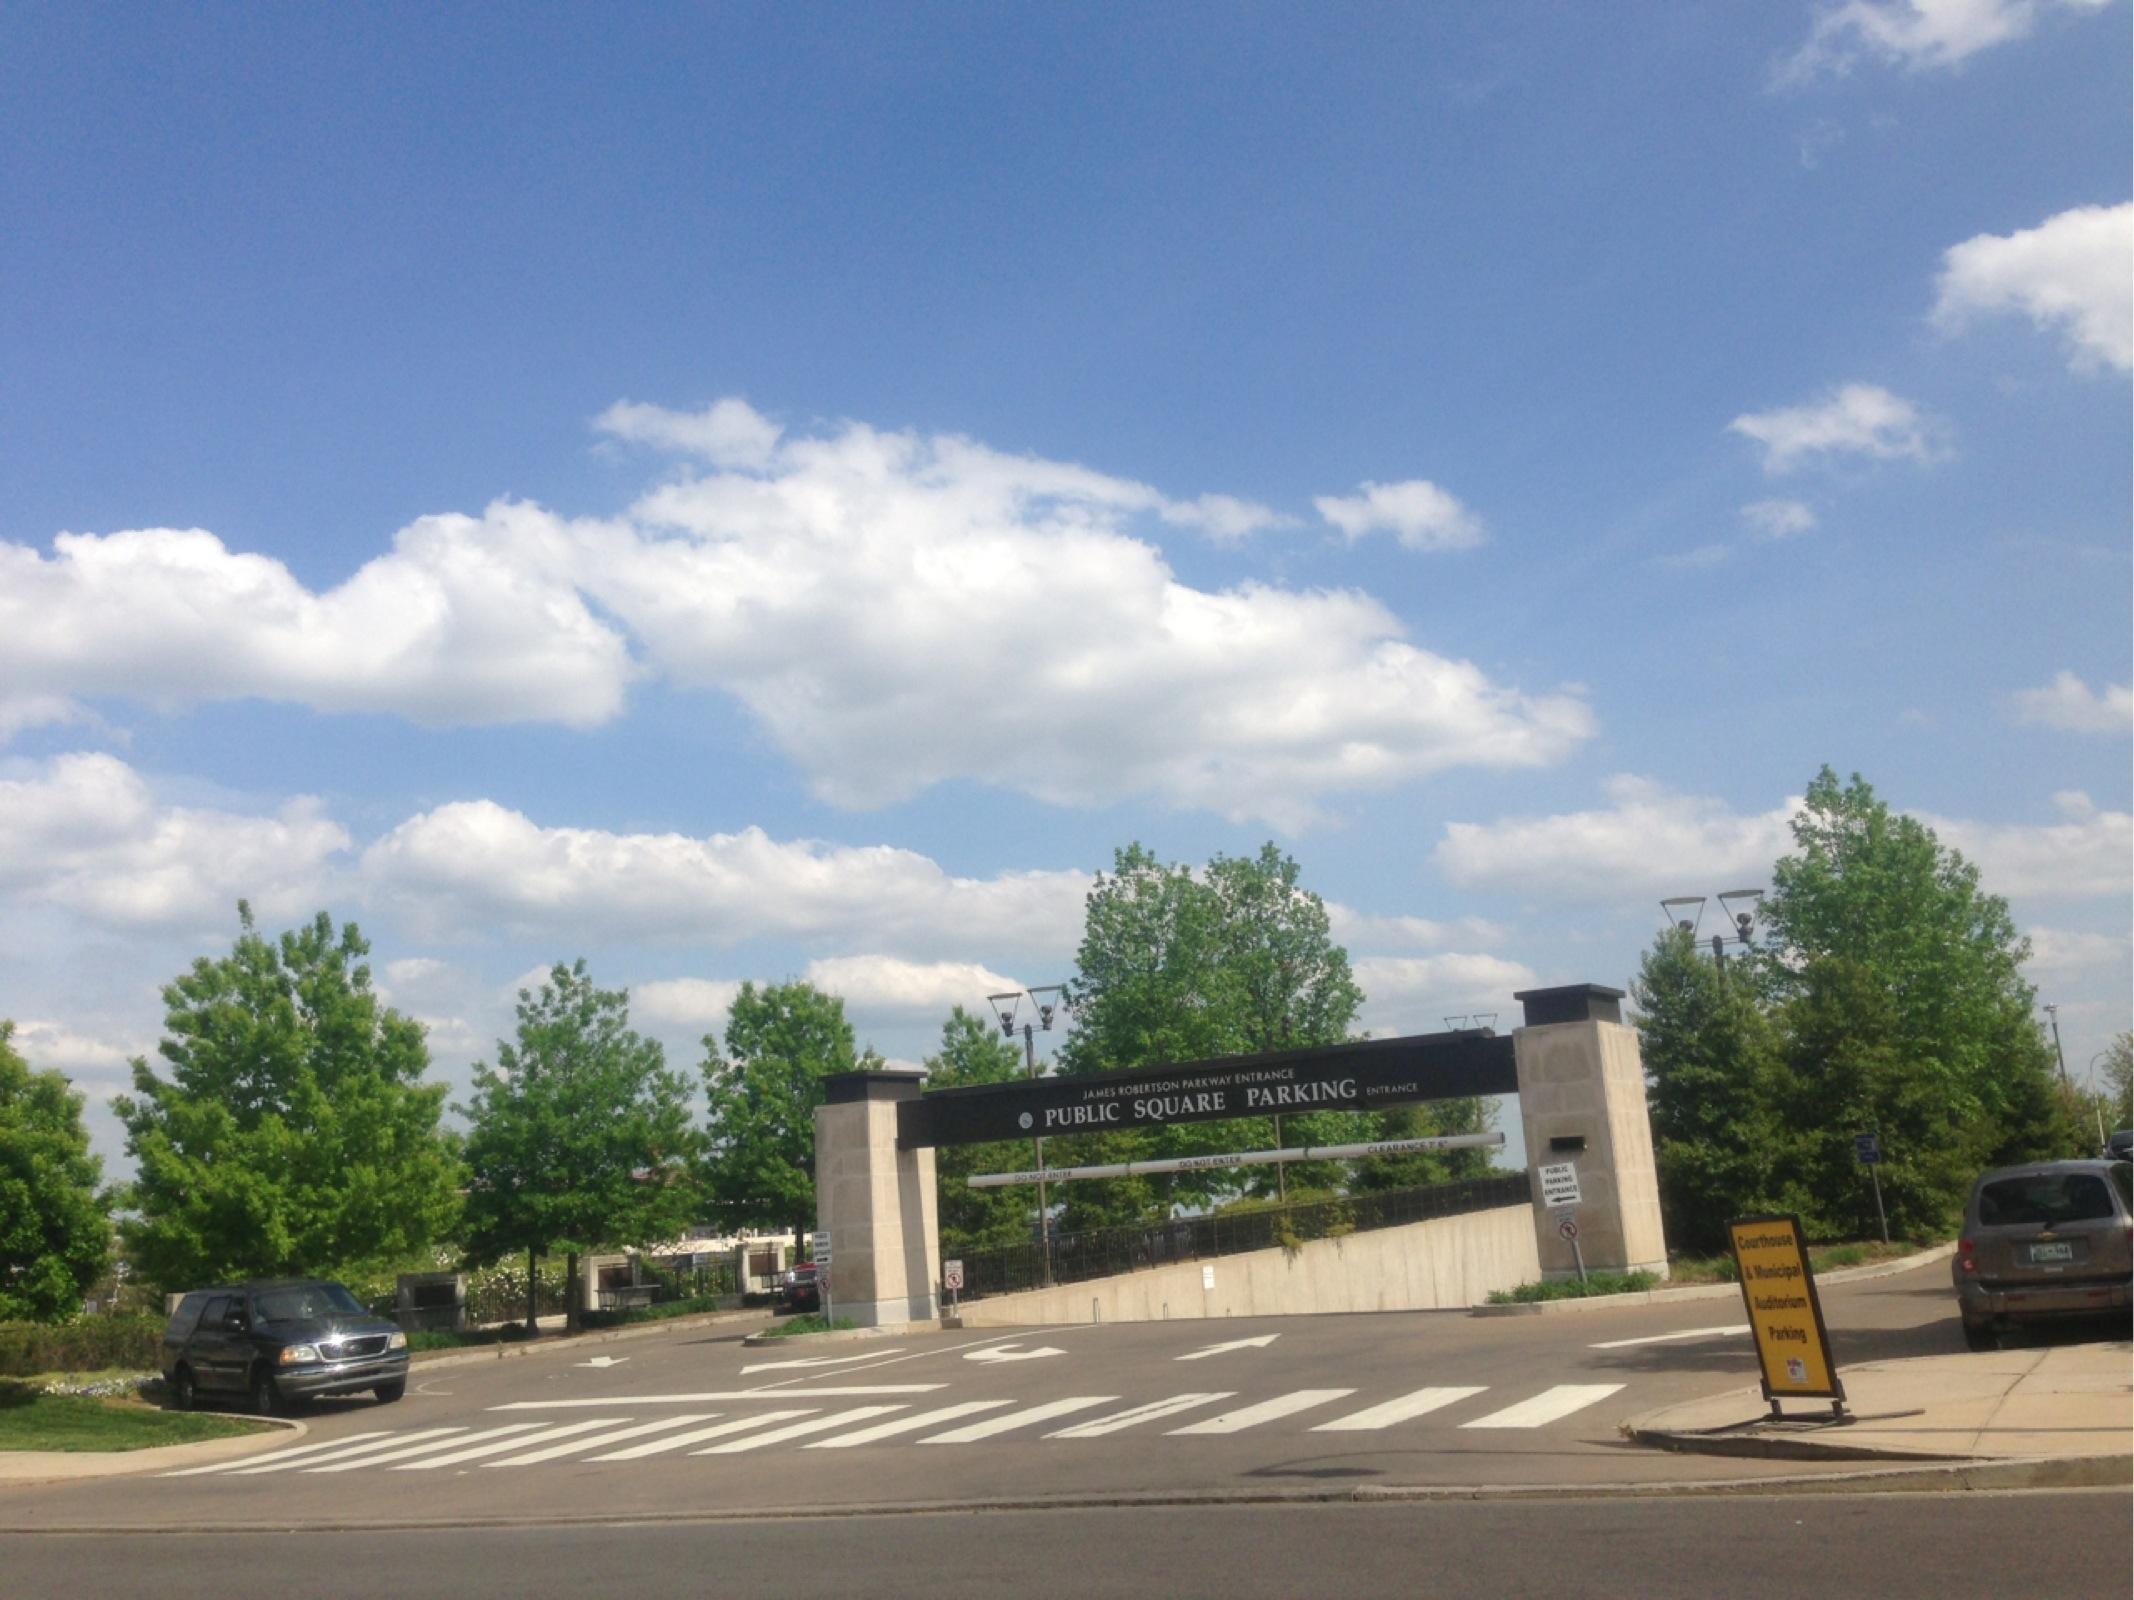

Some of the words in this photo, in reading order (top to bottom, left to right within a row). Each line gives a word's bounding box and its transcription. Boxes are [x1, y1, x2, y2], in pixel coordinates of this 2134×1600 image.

[1084, 1087, 1115, 1100] JAMES
[1118, 1080, 1180, 1096] ROBERTSON
[1182, 1075, 1232, 1089] PARKWAY
[1234, 1068, 1295, 1084] ENTRANCE
[1366, 1083, 1418, 1096] ENTRANCE
[1045, 1103, 1120, 1127] PUBLIC
[1133, 1092, 1226, 1120] SQUARE
[1246, 1078, 1358, 1108] PARKING
[1367, 1140, 1426, 1153] CLEARANCE
[1545, 1165, 1568, 1175] PUBLIC
[1545, 1176, 1573, 1186] PARKING
[1738, 1234, 1793, 1250] Courthouse
[1753, 1262, 1802, 1281] Municipal
[1754, 1294, 1808, 1310] Auditorium
[1768, 1326, 1808, 1344] Parking
